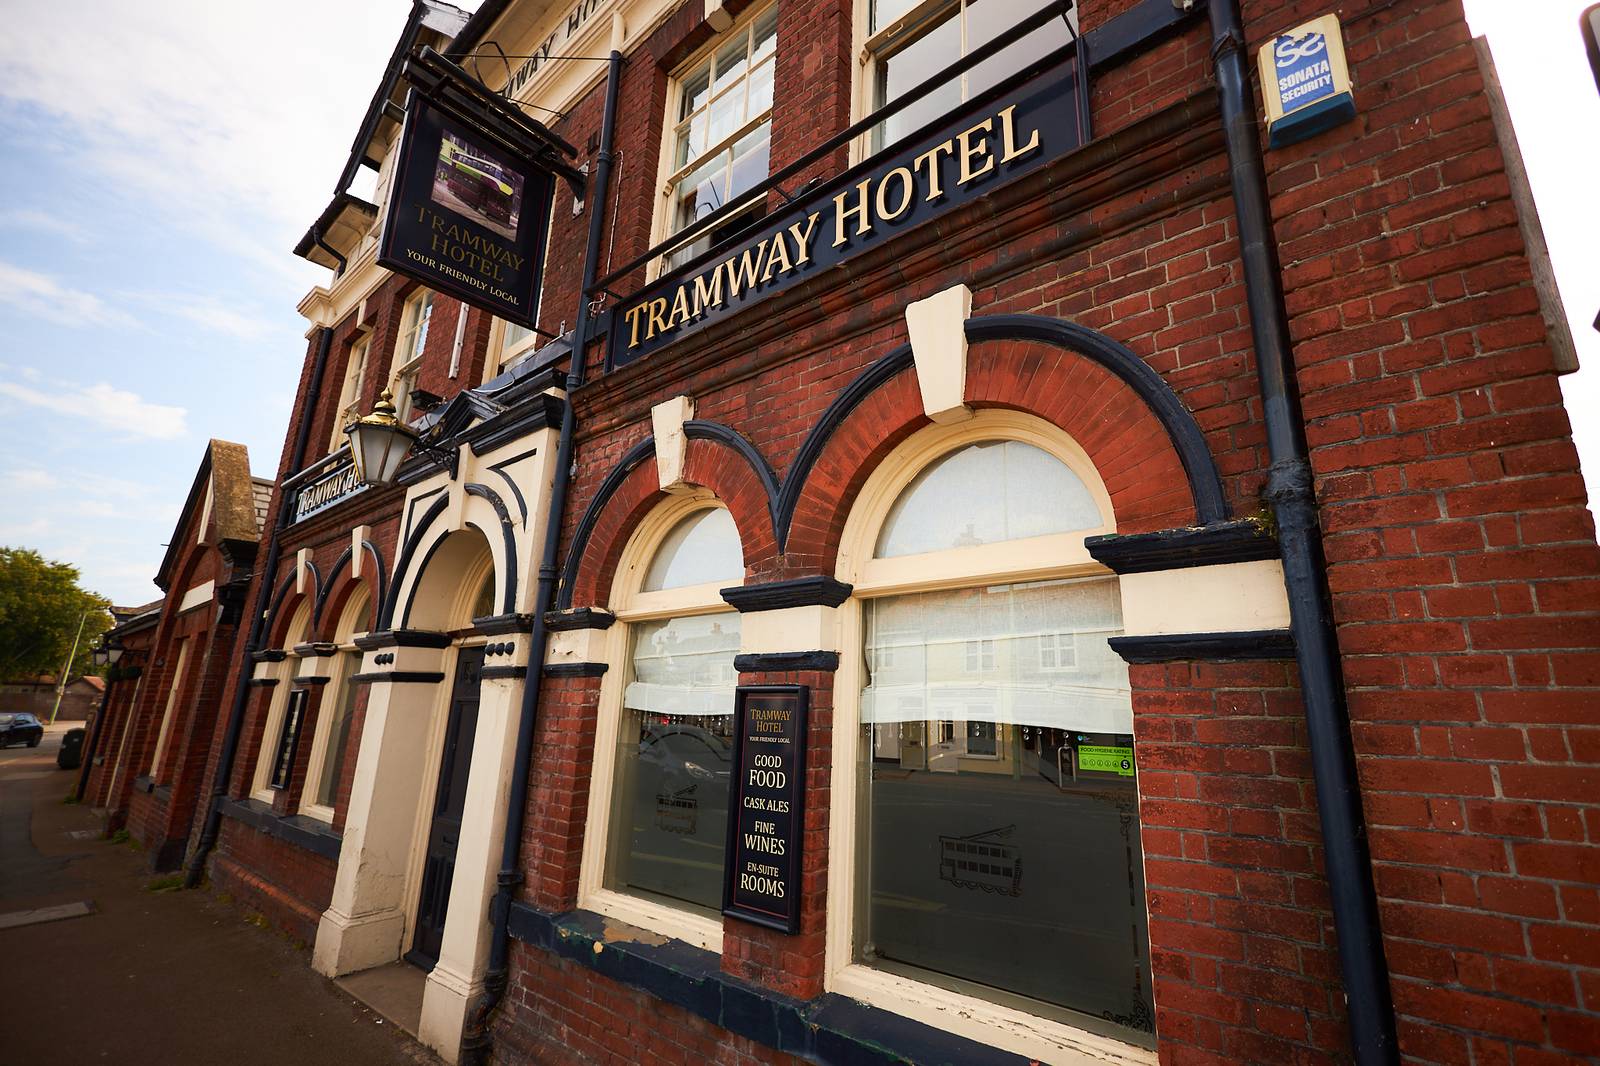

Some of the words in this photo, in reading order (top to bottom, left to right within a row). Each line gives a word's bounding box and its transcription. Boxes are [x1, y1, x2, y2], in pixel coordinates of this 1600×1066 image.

[1279, 60, 1329, 91] SONATA
[1281, 75, 1331, 103] SECURITY
[413, 204, 525, 272] TRAMWAY
[625, 211, 820, 350] TRAMWAY
[831, 104, 1040, 248] HOTEL
[431, 235, 505, 283] HOTEL
[406, 249, 436, 269] YOUR
[439, 263, 489, 292] FRIENDLY
[490, 286, 520, 306] LOCAL
[296, 472, 346, 516] TRAMWAY
[750, 708, 792, 721] TRAMWAY
[756, 721, 784, 733] HOTEL
[754, 754, 782, 768] GOOD
[749, 770, 786, 789] FOOD
[744, 796, 766, 810] CASK
[766, 799, 789, 813] ALES
[754, 821, 776, 835] FINE
[744, 834, 785, 856] WINES
[747, 862, 779, 877] EN-SUITE
[740, 873, 785, 898] ROOMS
